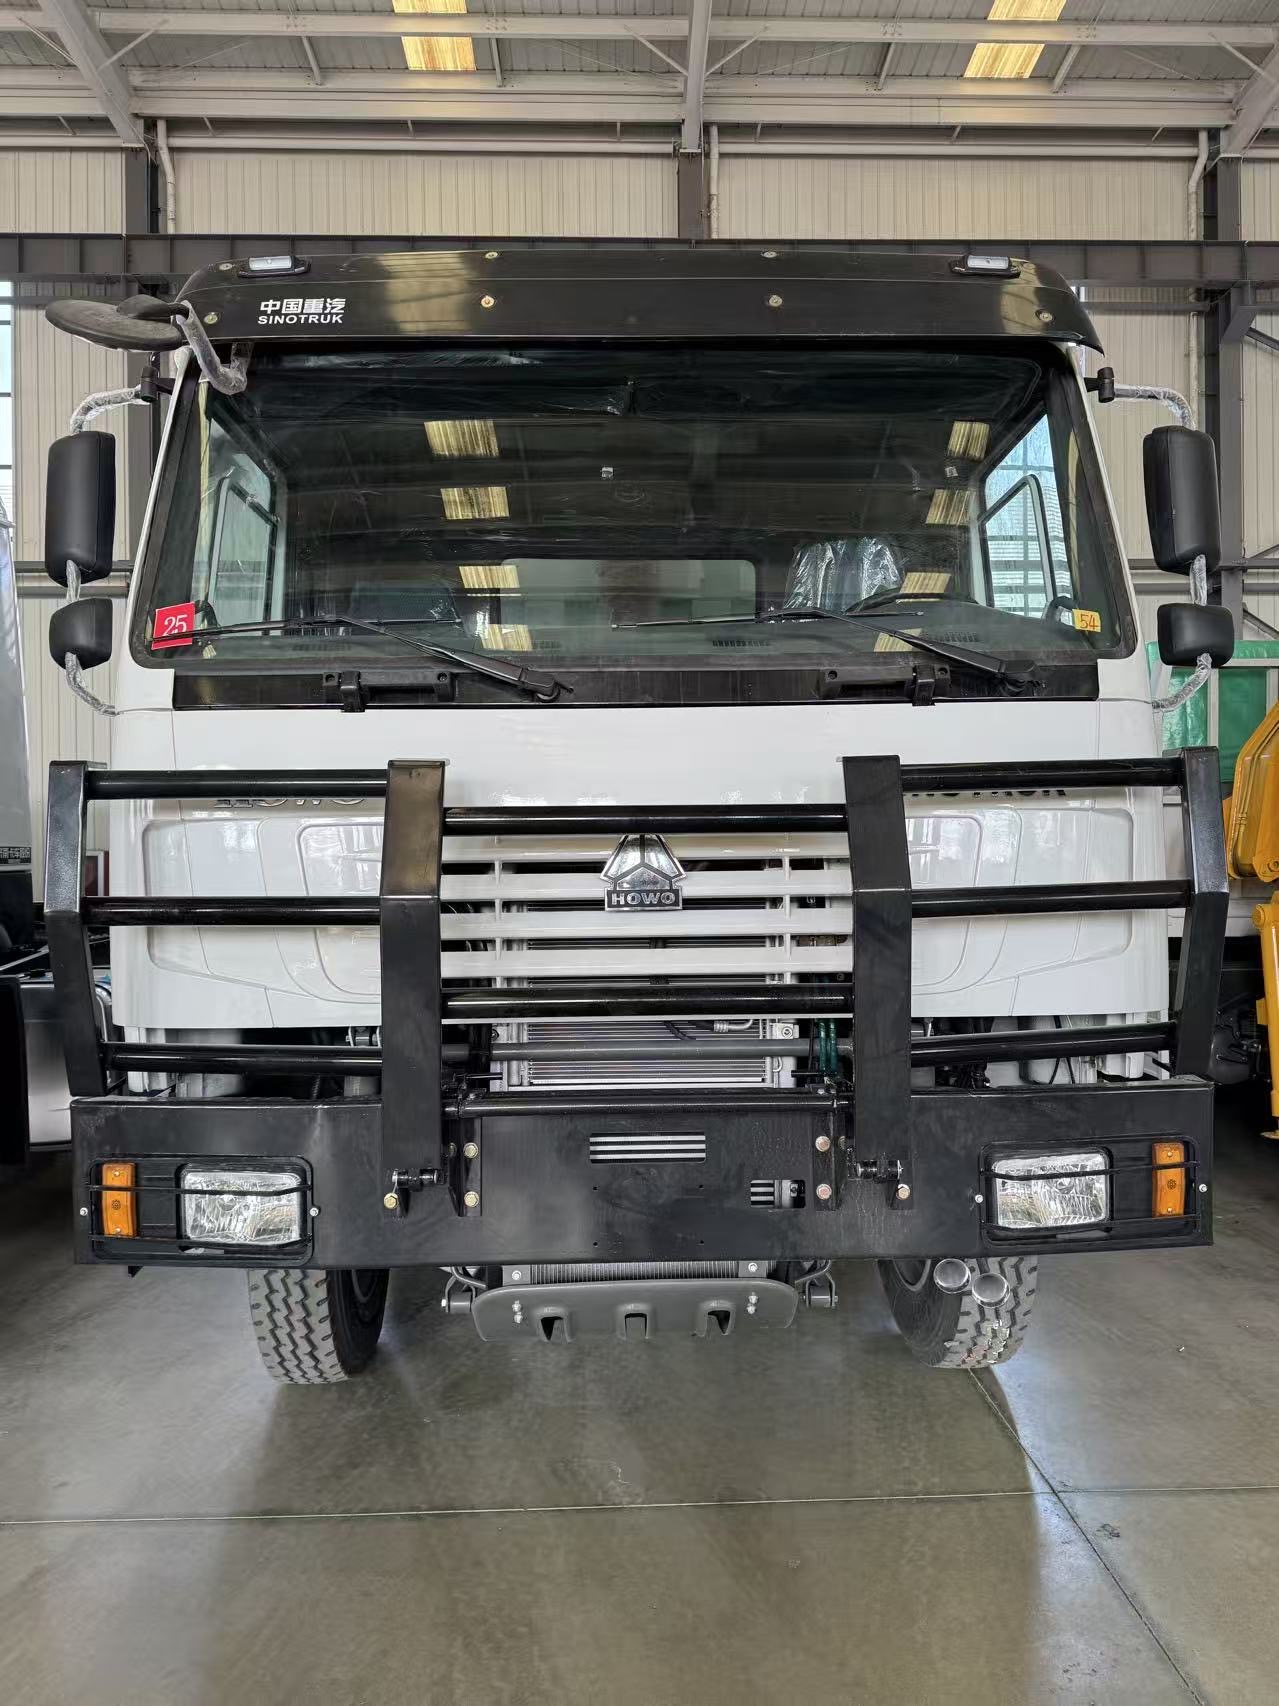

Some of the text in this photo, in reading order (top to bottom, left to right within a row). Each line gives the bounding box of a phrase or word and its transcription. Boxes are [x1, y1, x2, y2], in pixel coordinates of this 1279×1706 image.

[260, 298, 346, 314] 中国重汽
[258, 315, 344, 324] SINOTRUK
[163, 614, 188, 637] 25
[1080, 614, 1099, 630] 54
[611, 892, 676, 905] HOWO
